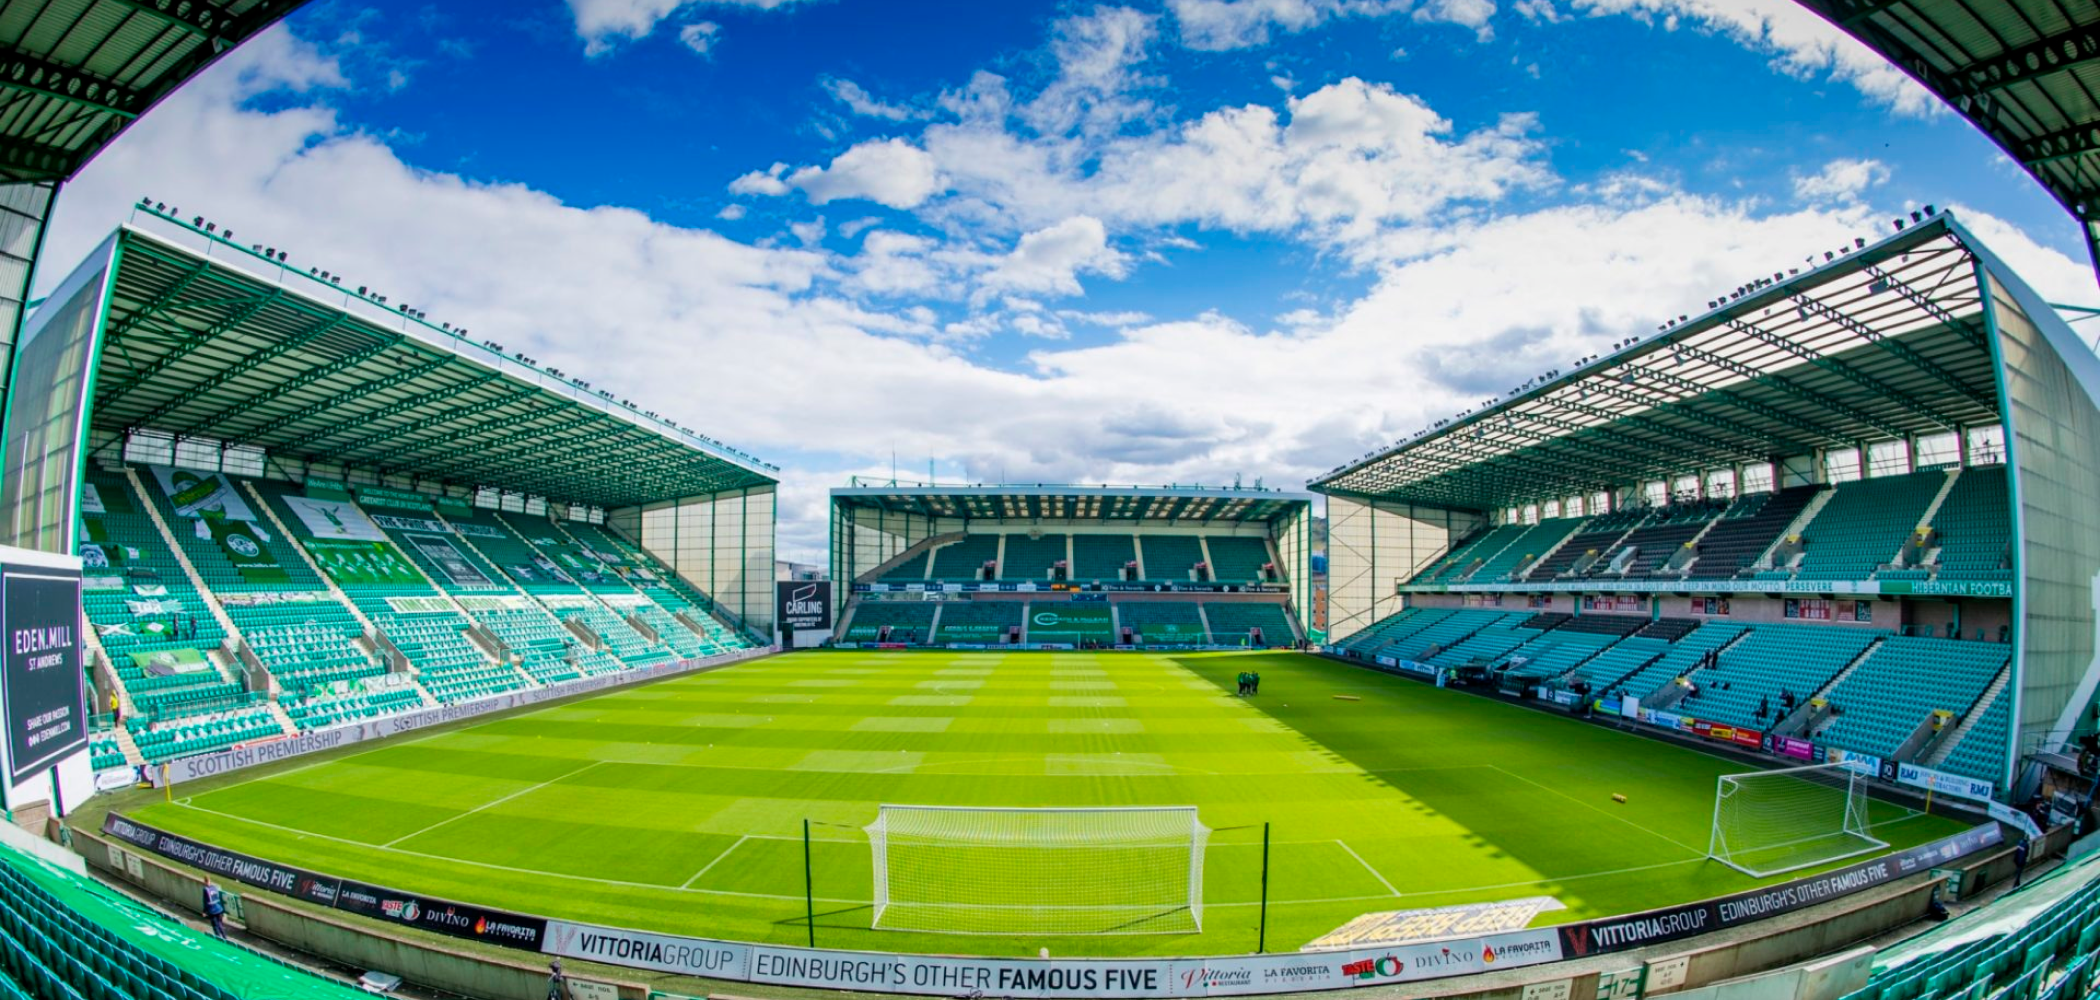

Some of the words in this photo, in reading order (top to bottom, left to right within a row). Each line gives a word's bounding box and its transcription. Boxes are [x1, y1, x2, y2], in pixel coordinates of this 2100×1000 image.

[407, 502, 432, 512] SCOTLAND
[1684, 582, 1699, 590] KEEP
[1702, 582, 1709, 590] IN
[1712, 582, 1730, 591] MIND
[1733, 582, 1749, 591] OUR
[1751, 582, 1780, 591] MOTTO
[1785, 582, 1833, 592] PERSEVERE
[1912, 582, 1966, 594] HIBERNIAN
[1970, 583, 2012, 596] FOOTBA
[786, 601, 823, 614] CARLING
[15, 625, 72, 655] EDEN.MILL
[28, 658, 36, 671] ST
[37, 653, 63, 667] ANDREWS
[533, 688, 565, 700] SCOTTISH
[569, 678, 607, 695] PREMIERSHIP
[27, 715, 42, 730] SHARE
[43, 711, 52, 724] OUR
[393, 709, 439, 732] SCOTTISH
[442, 700, 500, 720] PREMIERSHIP
[187, 750, 254, 778] SCOTTISH
[258, 731, 342, 761] PREMIERSHIP
[1900, 768, 1918, 780] RMJ
[1970, 783, 1990, 797] RMJ
[159, 836, 205, 864] EDINBURGH'S
[205, 853, 233, 872] OTHER
[232, 860, 270, 883] FAMOUS
[271, 869, 296, 890] FIVE
[341, 890, 350, 898] LA
[1719, 888, 1797, 922] EDINBURGH'S
[1798, 880, 1831, 901] OTHER
[1831, 873, 1868, 893] FAMOUS
[1868, 863, 1888, 882] FIVE
[381, 899, 402, 911] TASTE
[426, 908, 469, 928] DIVINO
[486, 920, 496, 930] LA
[497, 922, 536, 938] FAVORITA
[1494, 946, 1505, 955] LA
[1507, 940, 1551, 953] FAVORITA
[1415, 948, 1474, 968] DIVINO
[757, 954, 906, 985] EDINBURGH'S
[914, 964, 991, 989] OTHER
[999, 968, 1098, 990] FAMOUS
[1106, 968, 1158, 990] FIVE
[1264, 968, 1278, 978] LA
[1281, 965, 1330, 977] FAVORITA
[1342, 958, 1375, 977] TASTE
[1181, 966, 1252, 989] Vittoria
